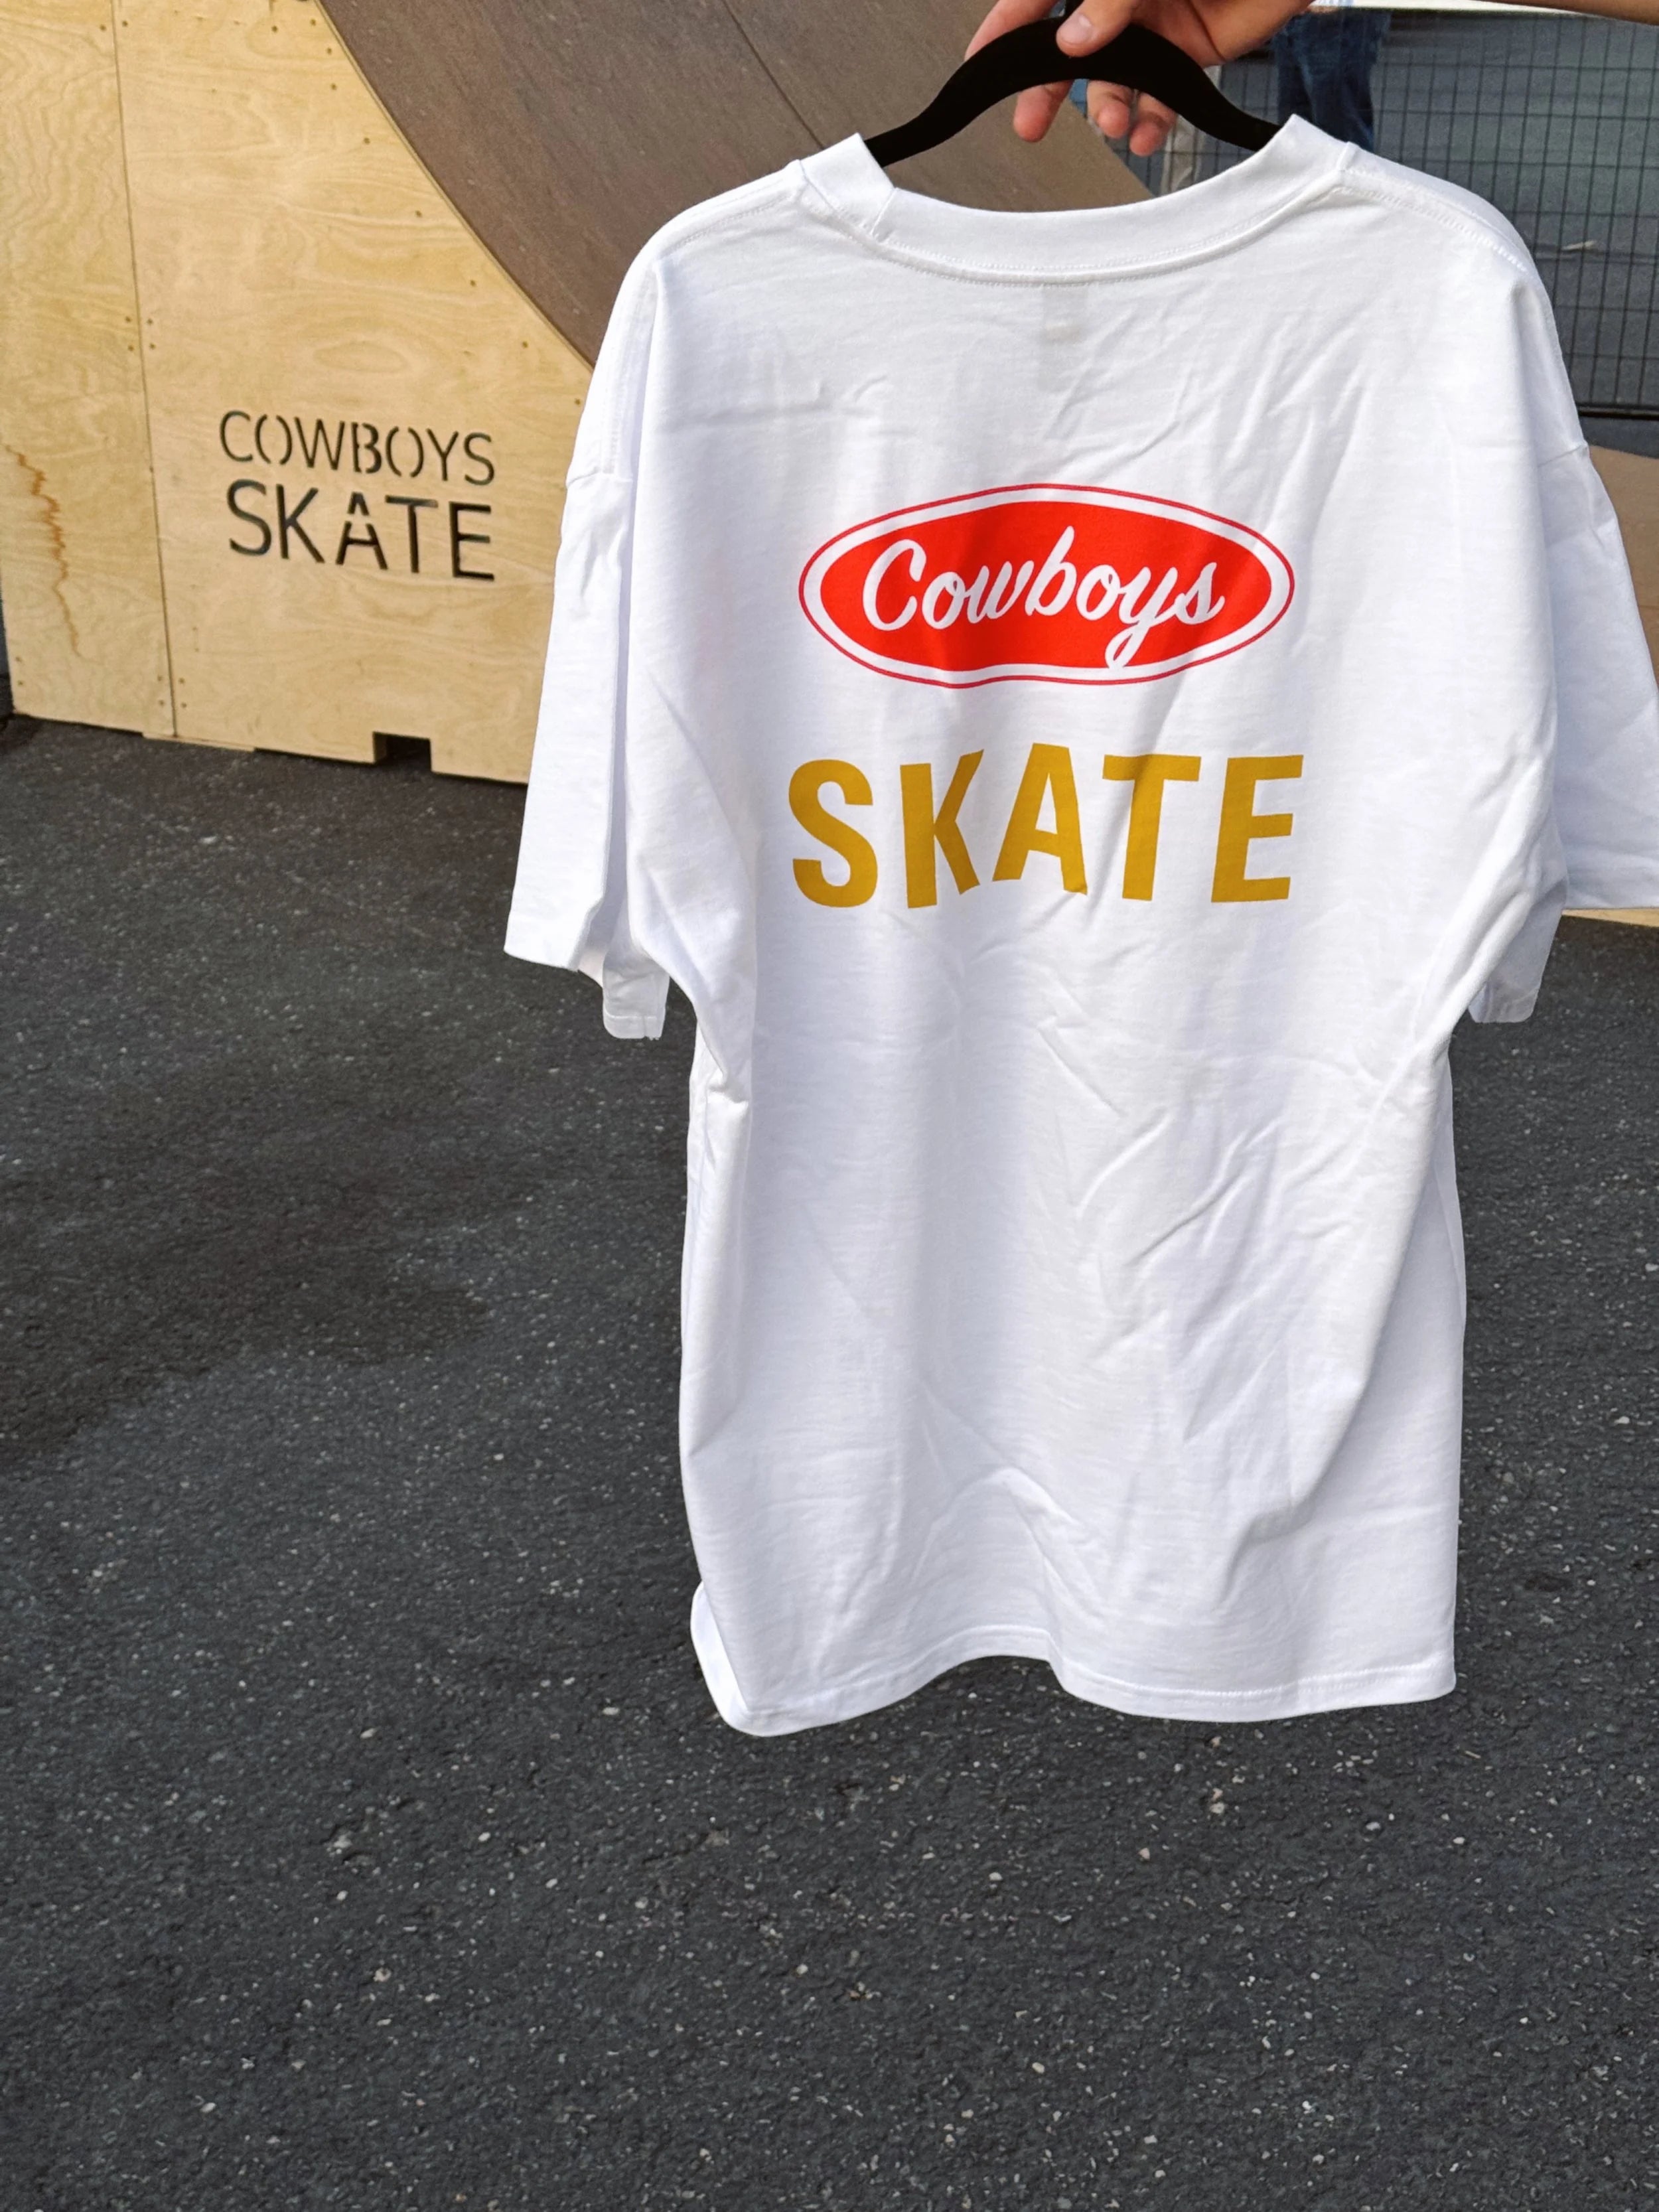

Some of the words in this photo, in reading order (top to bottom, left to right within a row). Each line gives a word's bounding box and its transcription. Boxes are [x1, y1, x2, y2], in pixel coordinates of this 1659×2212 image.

[220, 410, 495, 486] COWBOYS
[226, 479, 496, 582] SKATE
[863, 526, 1226, 668] Cowboys
[788, 742, 1304, 909] SKATE
